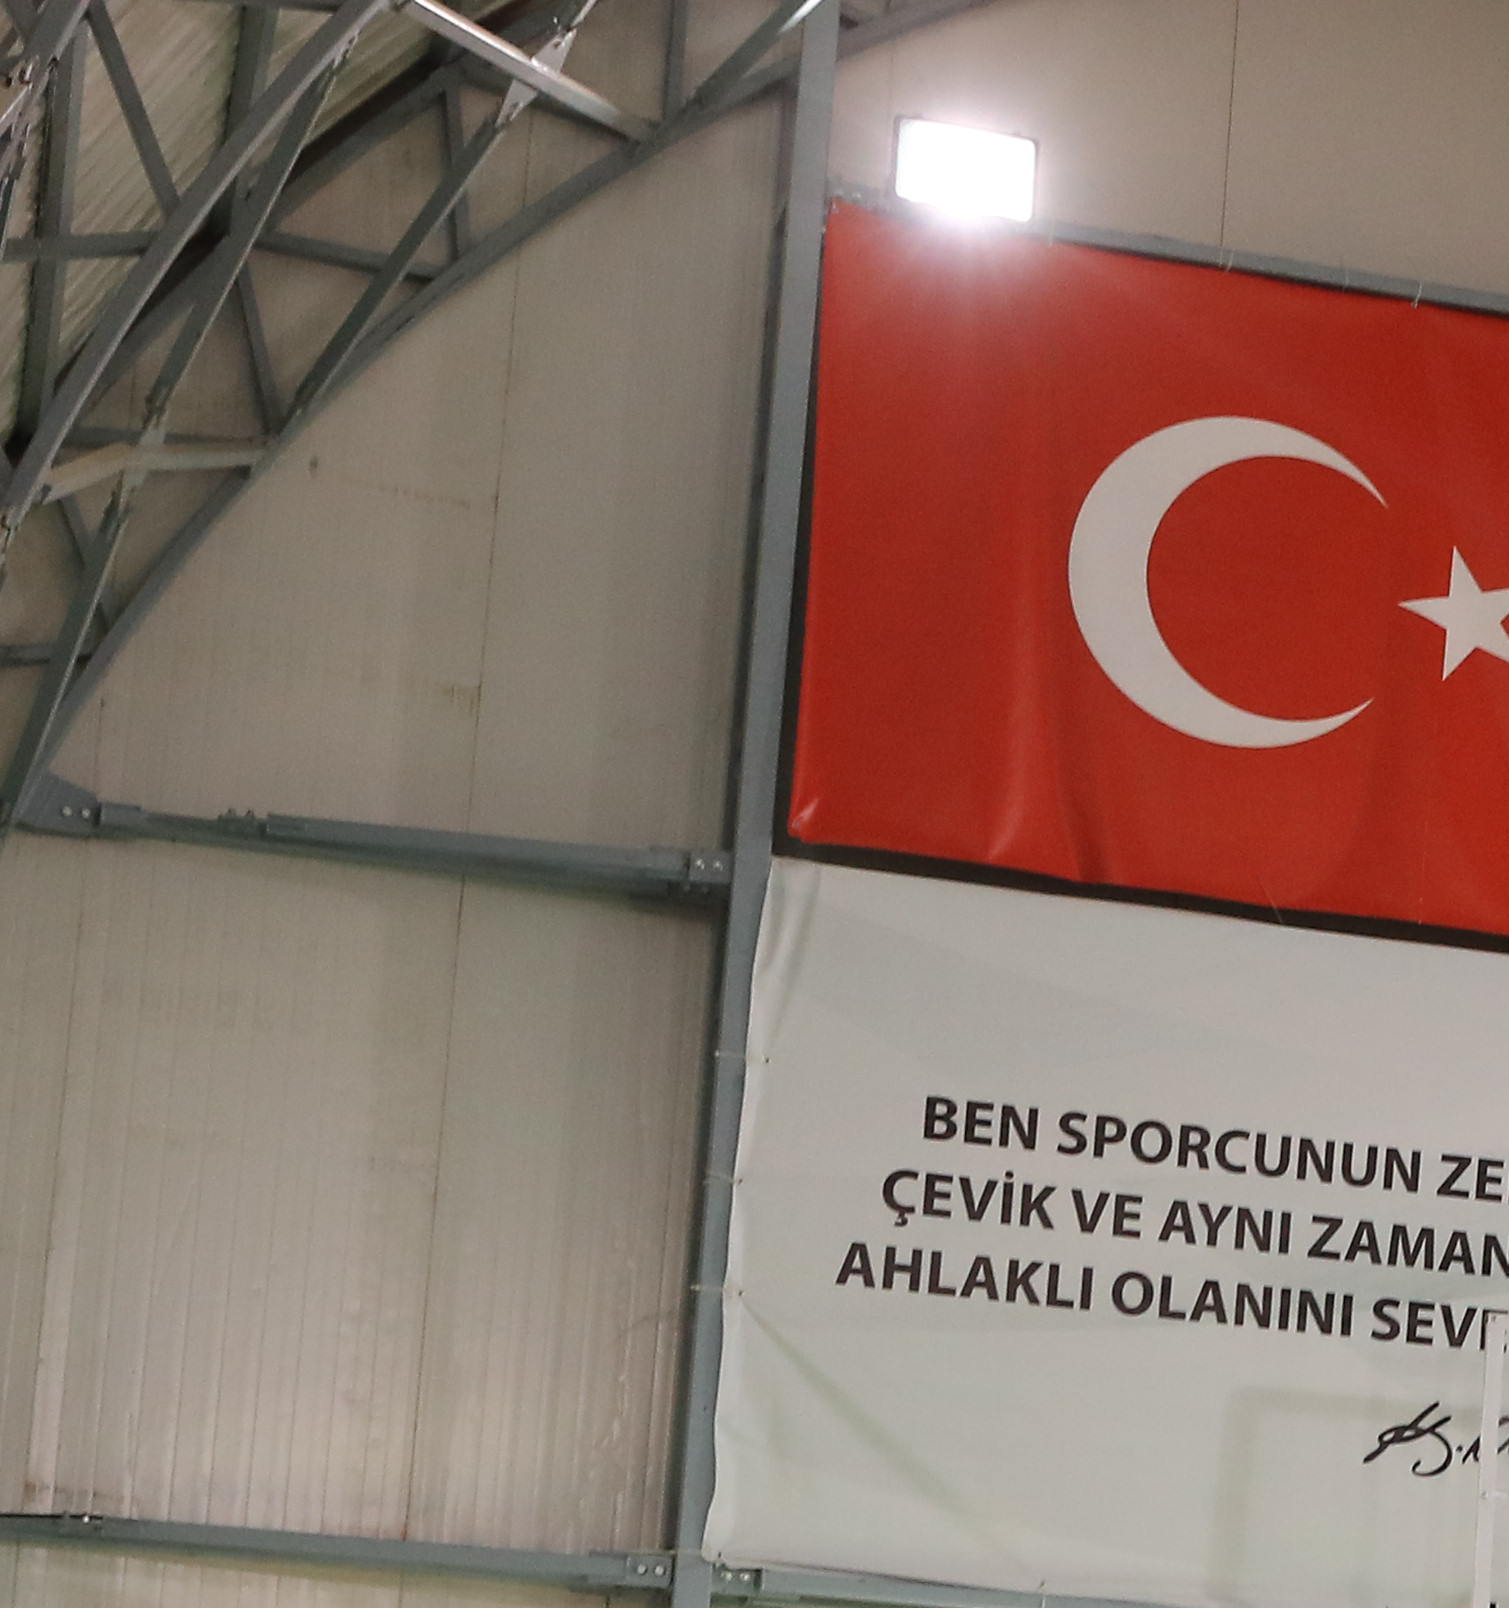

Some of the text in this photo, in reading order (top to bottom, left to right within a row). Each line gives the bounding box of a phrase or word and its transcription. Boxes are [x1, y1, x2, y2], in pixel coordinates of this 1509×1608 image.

[922, 1094, 1040, 1152] BEN
[1055, 1110, 1423, 1195] SPORCUNUN
[881, 1168, 1058, 1231] ÇEVİK
[1070, 1187, 1144, 1240] VE
[1157, 1198, 1293, 1256] AYNI
[834, 1240, 1095, 1312] AHLAKLI
[1110, 1270, 1355, 1338] OLANINI
